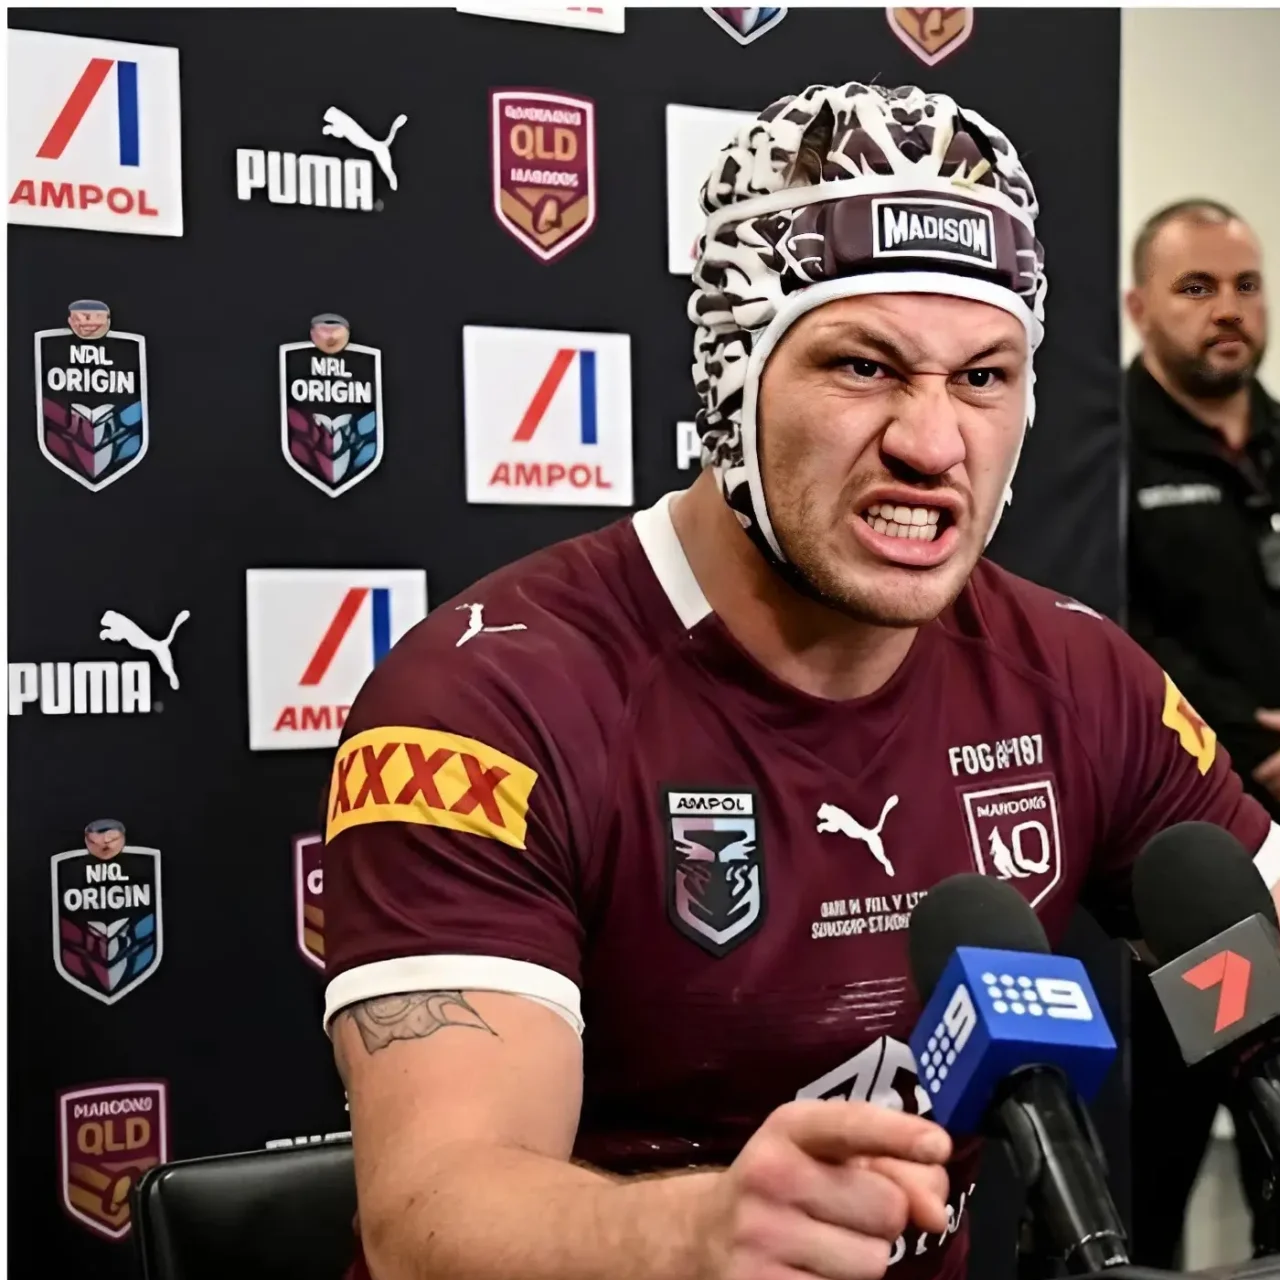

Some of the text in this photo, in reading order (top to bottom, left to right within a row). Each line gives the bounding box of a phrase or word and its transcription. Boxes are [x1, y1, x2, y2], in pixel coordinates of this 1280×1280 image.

[510, 123, 578, 161] QLD
[9, 179, 159, 216] AMPOL
[236, 148, 373, 211] PUMA
[883, 206, 988, 256] MADISON
[47, 366, 134, 394] ORIGIN
[291, 379, 372, 404] ORIGIN
[488, 461, 613, 489] AMPOL
[8, 661, 151, 715] PUMA
[949, 743, 994, 776] FOG
[331, 742, 512, 829] XXXX
[64, 883, 150, 912] ORIGIN
[1181, 950, 1251, 1034] 7
[77, 1116, 151, 1156] QLD
